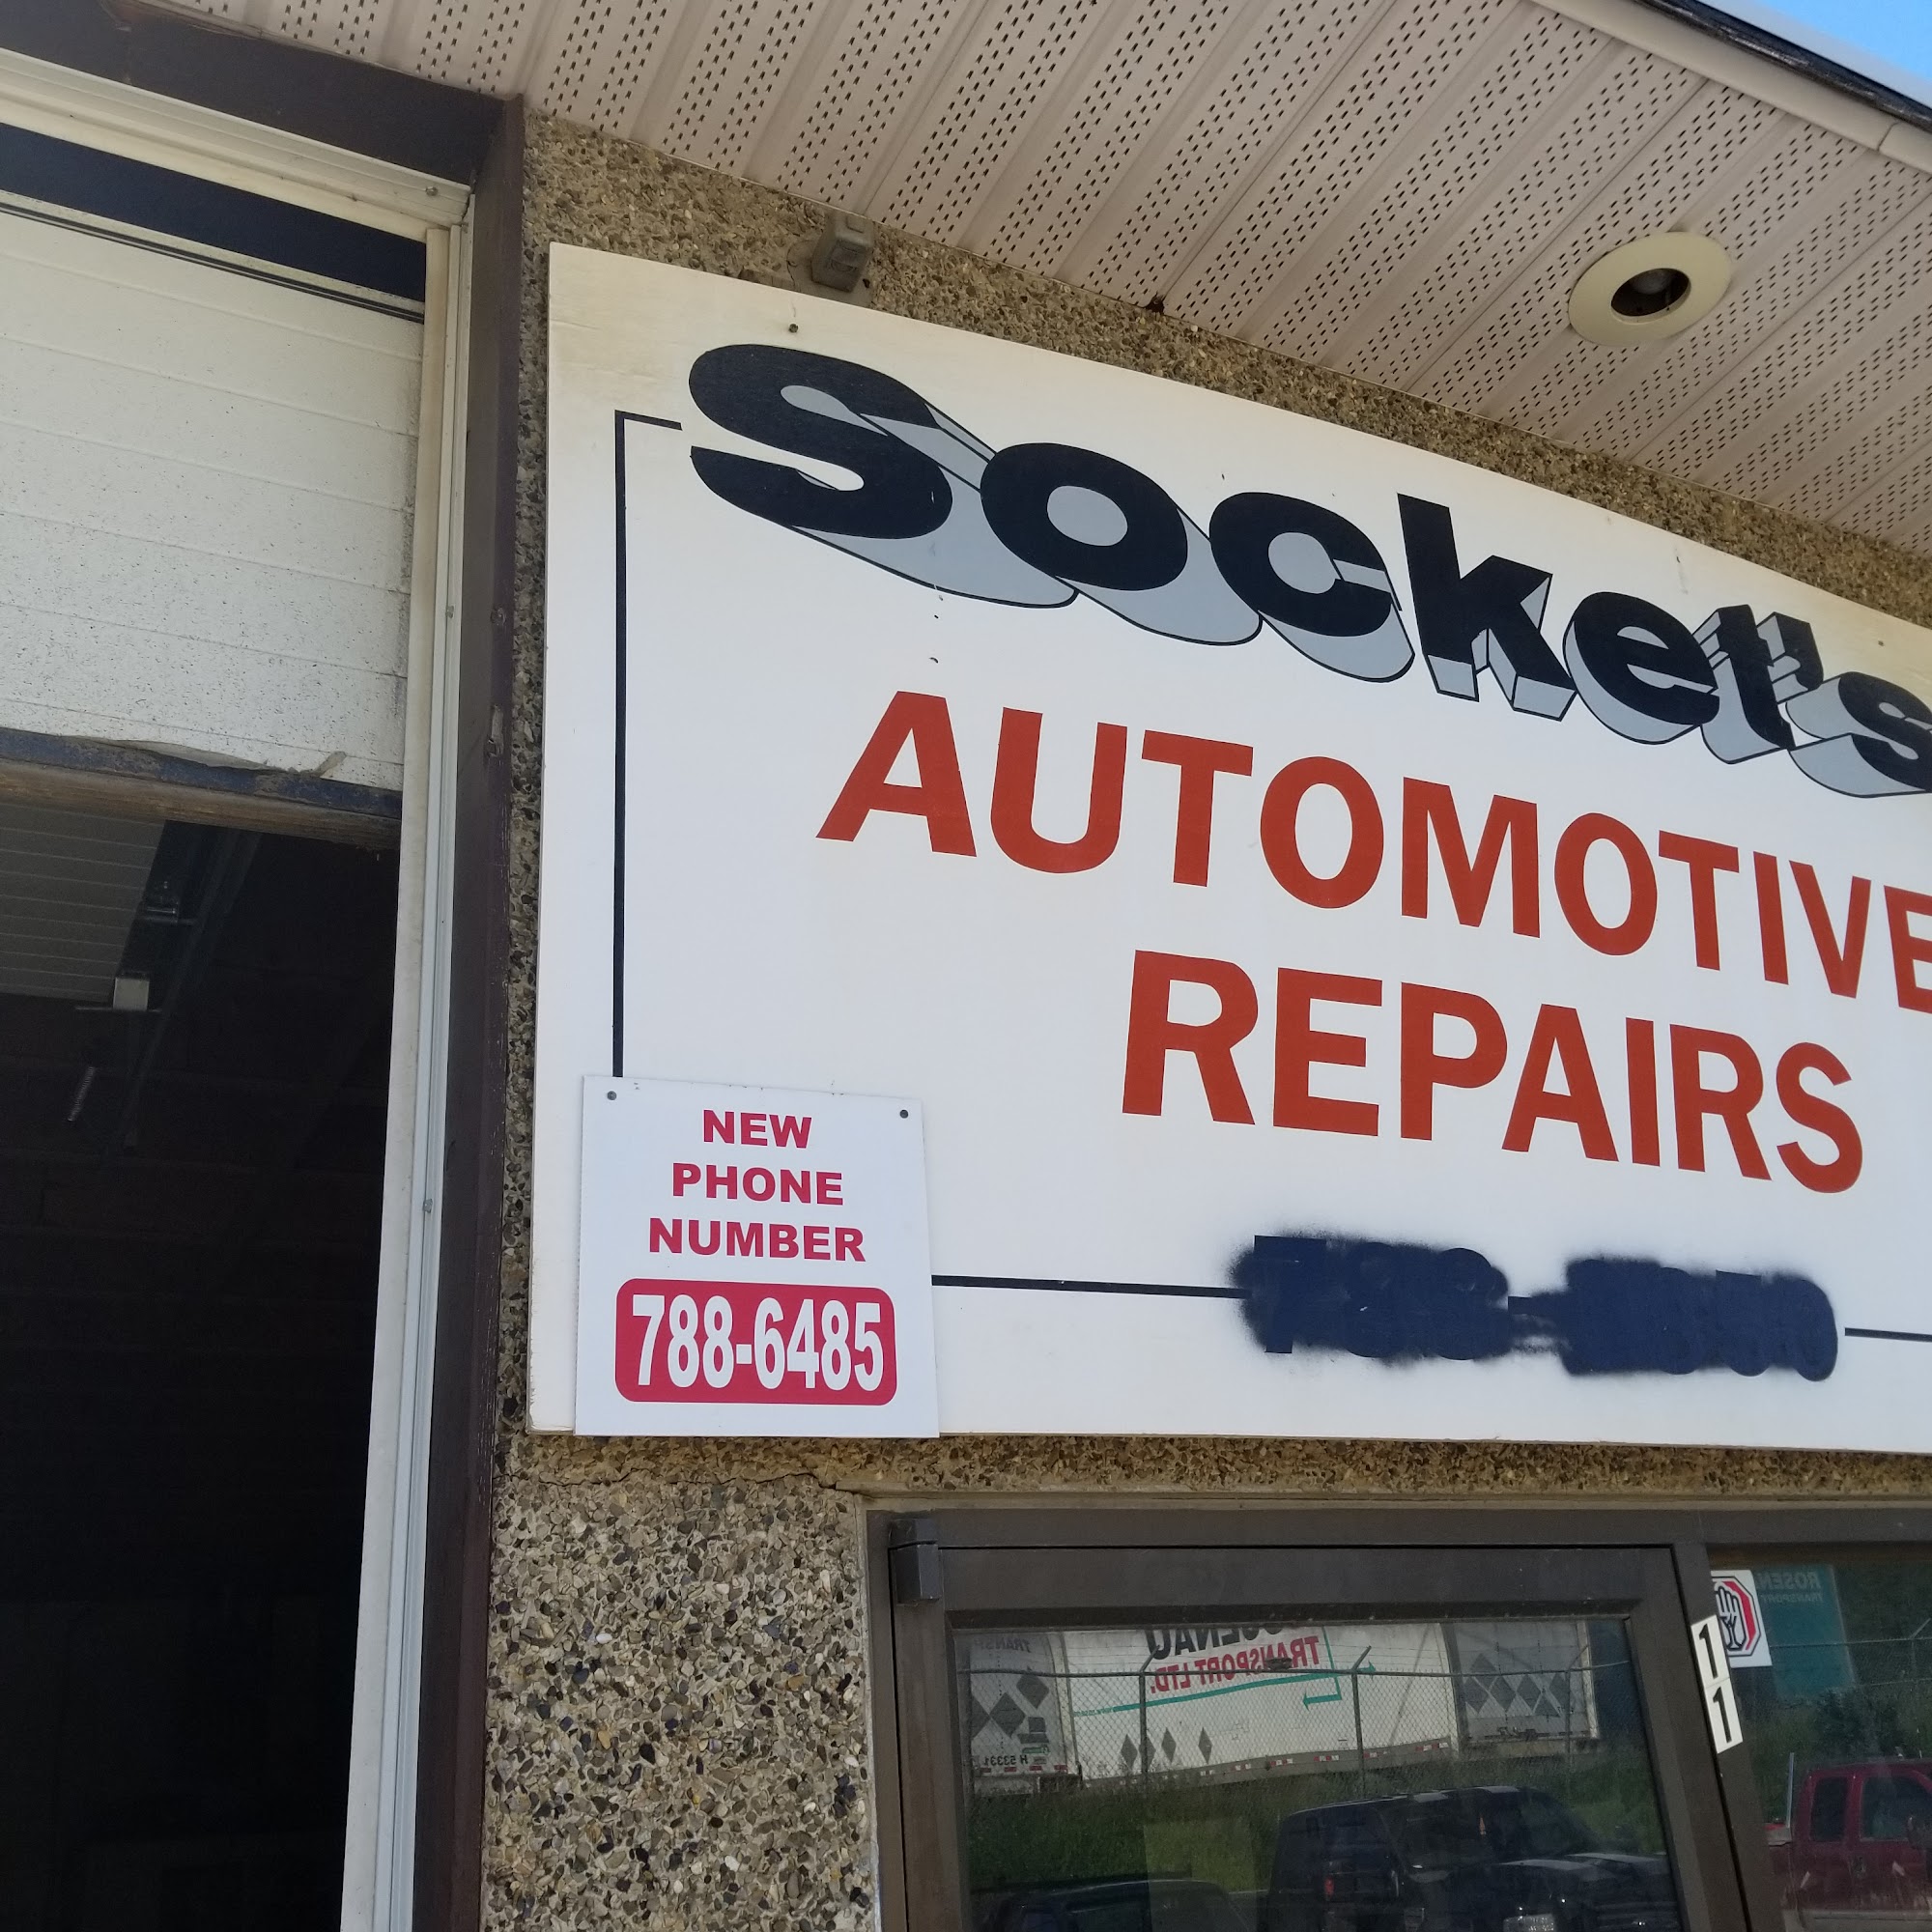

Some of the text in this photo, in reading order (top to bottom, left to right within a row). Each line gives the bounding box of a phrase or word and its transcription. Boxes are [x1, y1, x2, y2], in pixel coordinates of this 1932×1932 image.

[688, 344, 1932, 798] Socket's
[816, 690, 1932, 1014] AUTOMOTIVE
[1122, 950, 1864, 1194] REPAIRS
[702, 1109, 812, 1150] NEW
[672, 1162, 844, 1206] PHONE
[648, 1217, 867, 1263] NUMBER
[632, 1293, 885, 1392] 788-6485
